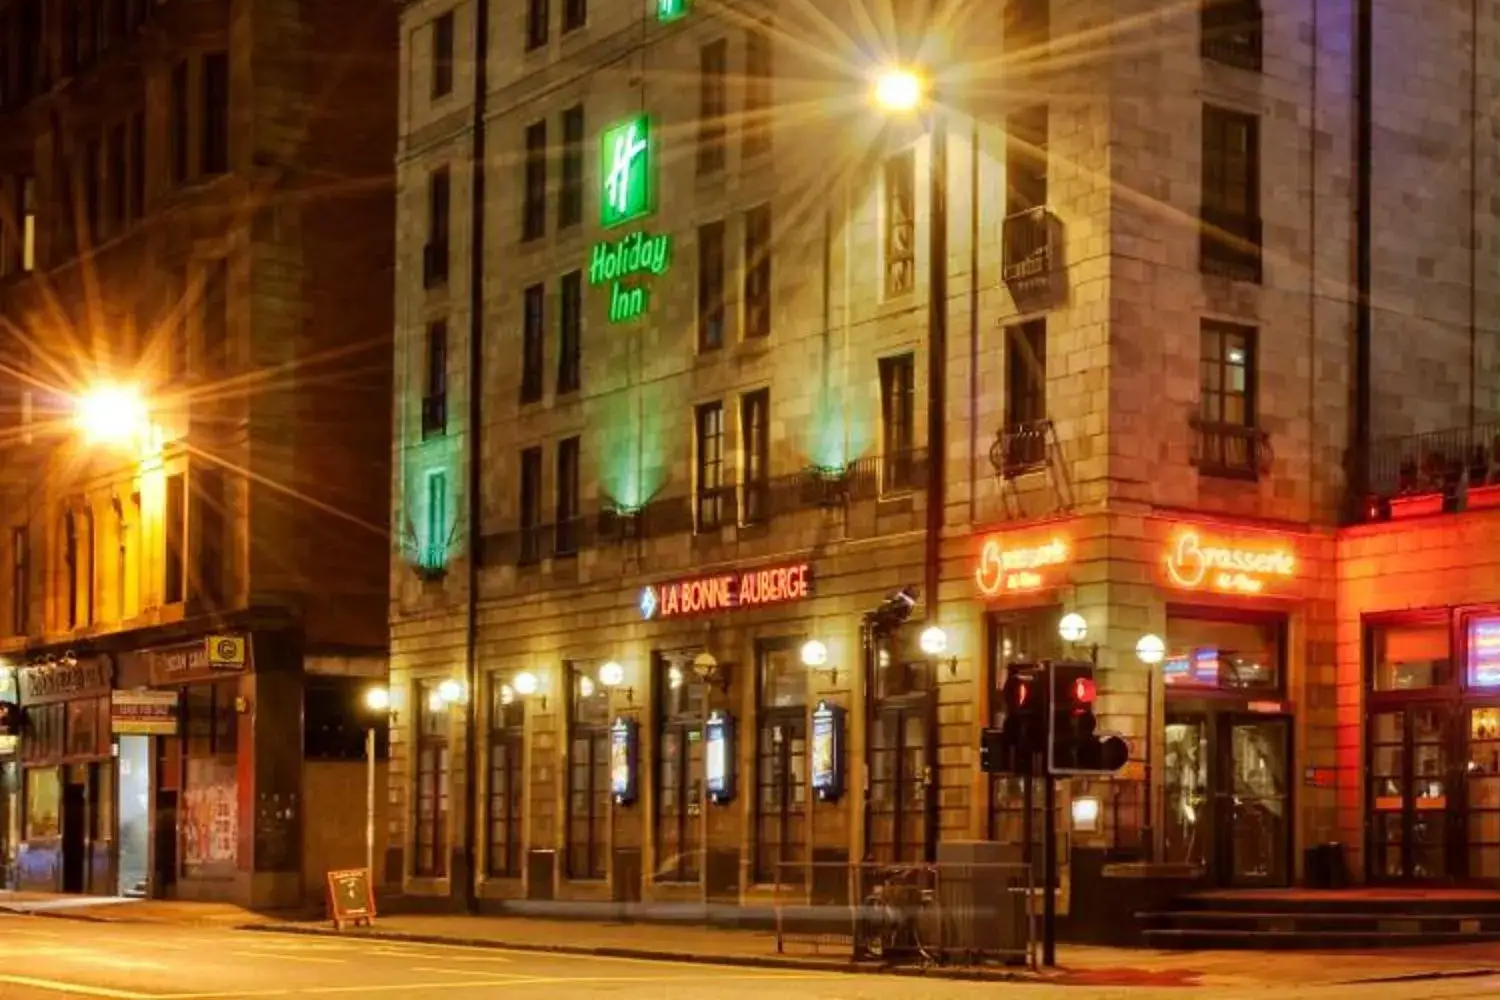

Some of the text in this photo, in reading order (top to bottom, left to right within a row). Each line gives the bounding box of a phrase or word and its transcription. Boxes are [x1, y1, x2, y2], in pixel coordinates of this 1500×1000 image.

[590, 231, 668, 284] Holiday
[610, 280, 643, 322] Inn
[661, 563, 809, 615] LA BONNE AUBERGE
